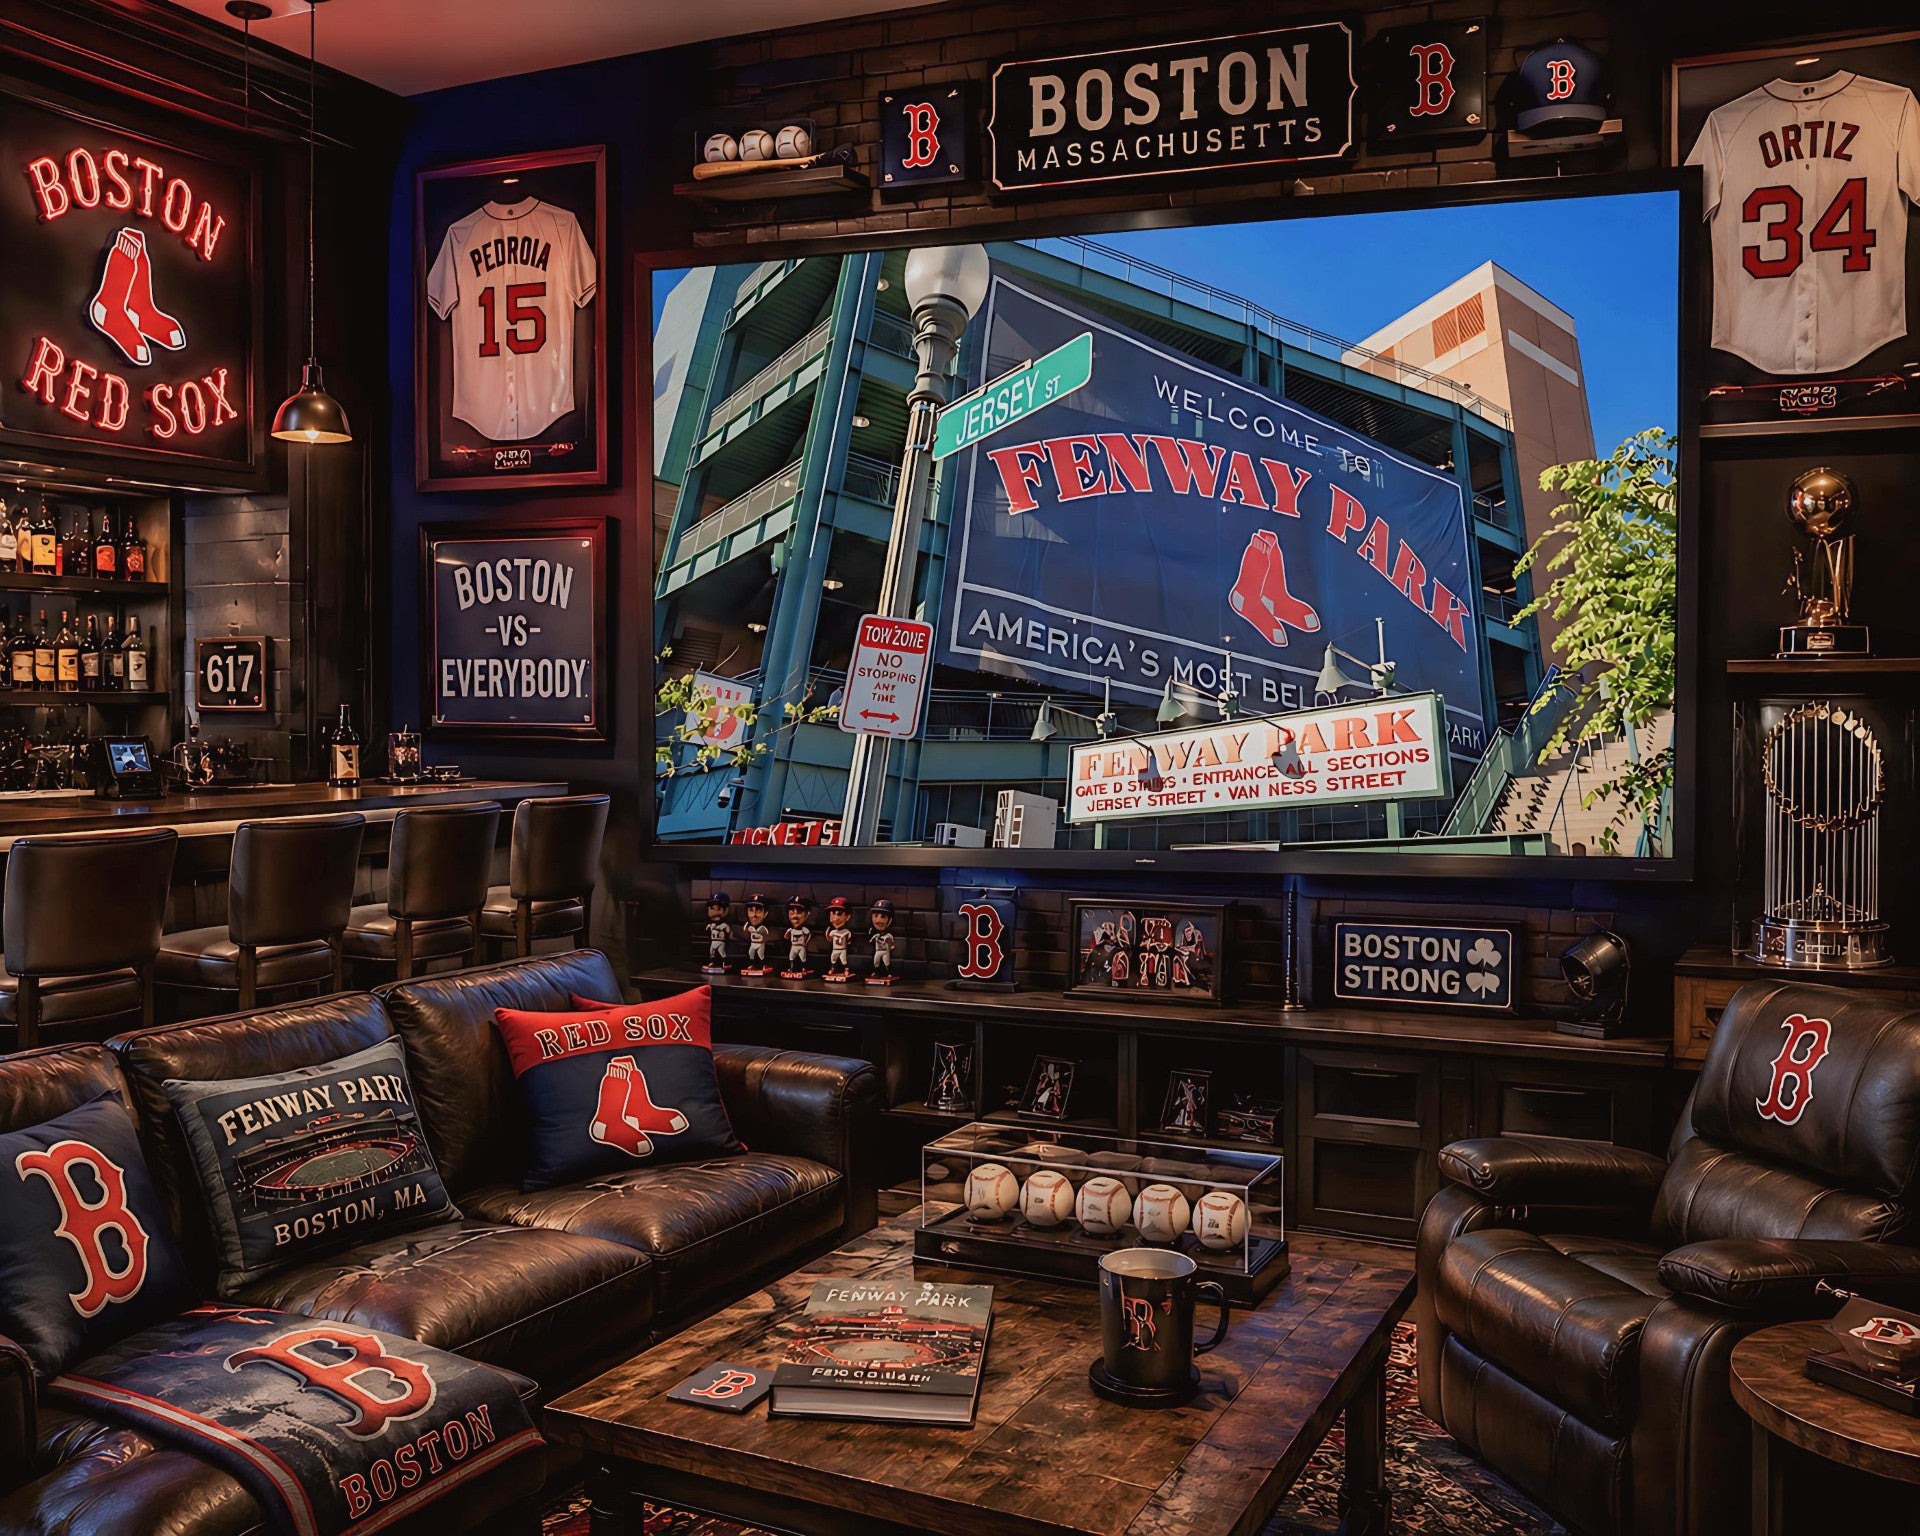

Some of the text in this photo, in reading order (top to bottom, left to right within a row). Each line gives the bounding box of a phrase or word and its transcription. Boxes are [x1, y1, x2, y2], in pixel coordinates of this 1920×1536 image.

[1028, 44, 1310, 137] BOSTON
[1409, 42, 1456, 117] B
[1546, 60, 1576, 100] B
[902, 102, 941, 168] B
[1016, 117, 1323, 172] MASSACHUSETTS
[1758, 120, 1860, 169] ORTIZ
[27, 147, 226, 262] BOSTON
[1741, 177, 1876, 279] 34
[470, 236, 553, 277] PEDROIA
[478, 282, 547, 358] 15
[22, 336, 237, 439] RED SOX
[956, 370, 1061, 444] JERSEY ST
[1154, 375, 1371, 476] WELCOME TO
[986, 432, 1472, 653] FENWAY PARK
[454, 558, 574, 611] BOSTON
[865, 625, 892, 644] TOW
[876, 653, 902, 668] NO
[968, 608, 1159, 677] AMERICA'S
[206, 654, 254, 693] 617
[858, 667, 916, 685] STOPPING
[1076, 783, 1107, 798] GATE
[1114, 782, 1122, 794] D
[1193, 765, 1279, 785] ENTRANCE
[1327, 747, 1430, 772] SECTIONS
[1080, 708, 1422, 781] FENWAY PARK
[1087, 771, 1406, 812] JERSEY STREET VAN NESS STREET
[958, 904, 1004, 979] B
[1344, 934, 1461, 963] BOSTON
[1344, 965, 1461, 995] STRONG
[534, 1013, 692, 1060] RED SOX
[1755, 1013, 1832, 1126] B
[218, 1085, 335, 1146] FENWAY
[394, 1183, 427, 1210] MA
[15, 1139, 149, 1318] B
[826, 1288, 972, 1308] FENWAY PARK
[223, 1327, 437, 1441] B
[339, 1403, 496, 1519] BOSTON
